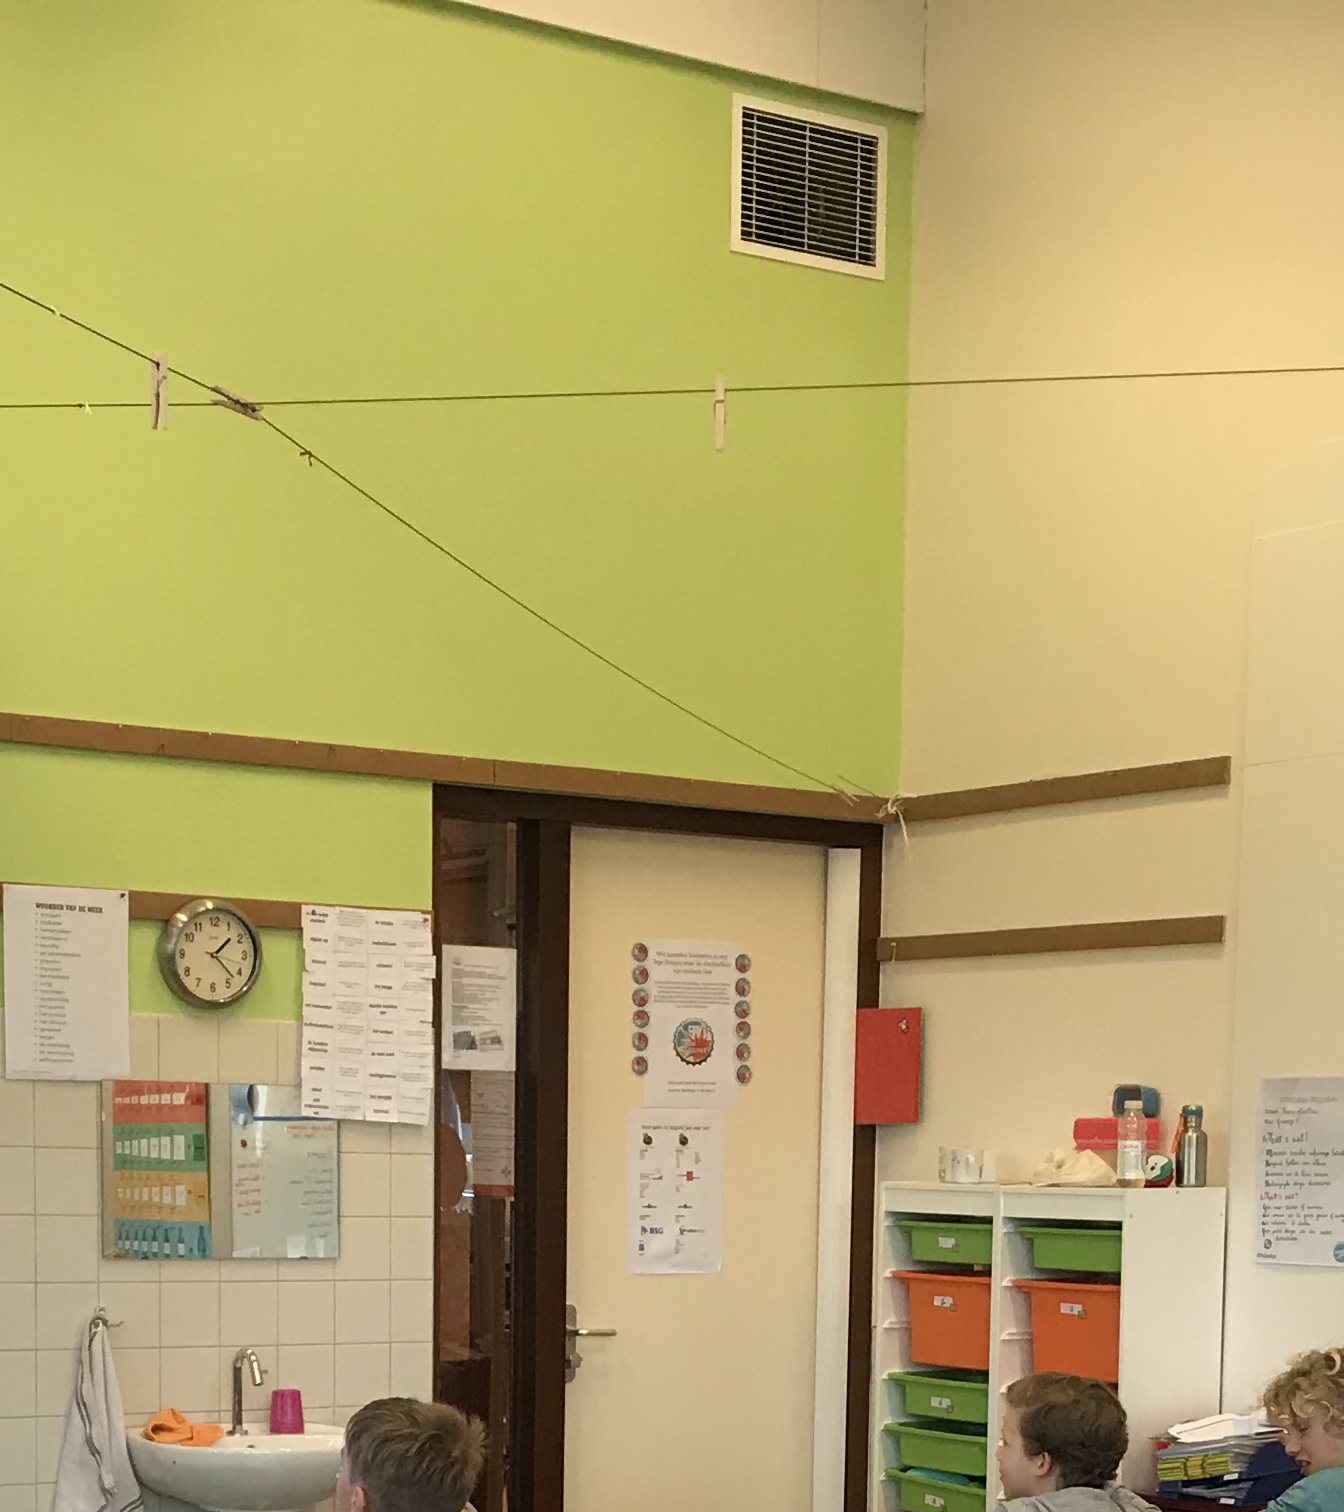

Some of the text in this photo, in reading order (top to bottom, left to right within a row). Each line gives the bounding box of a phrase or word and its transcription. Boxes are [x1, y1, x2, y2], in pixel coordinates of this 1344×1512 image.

[194, 922, 202, 932] 11
[209, 916, 220, 928] 12
[226, 921, 230, 932] 1
[184, 932, 195, 943] 10
[236, 933, 244, 944] 2
[178, 948, 186, 959] 9
[241, 950, 248, 961] 3
[184, 966, 191, 978] 8
[236, 966, 242, 977] 4
[195, 977, 202, 988] 7
[210, 982, 216, 993] 6
[225, 978, 232, 989] 5
